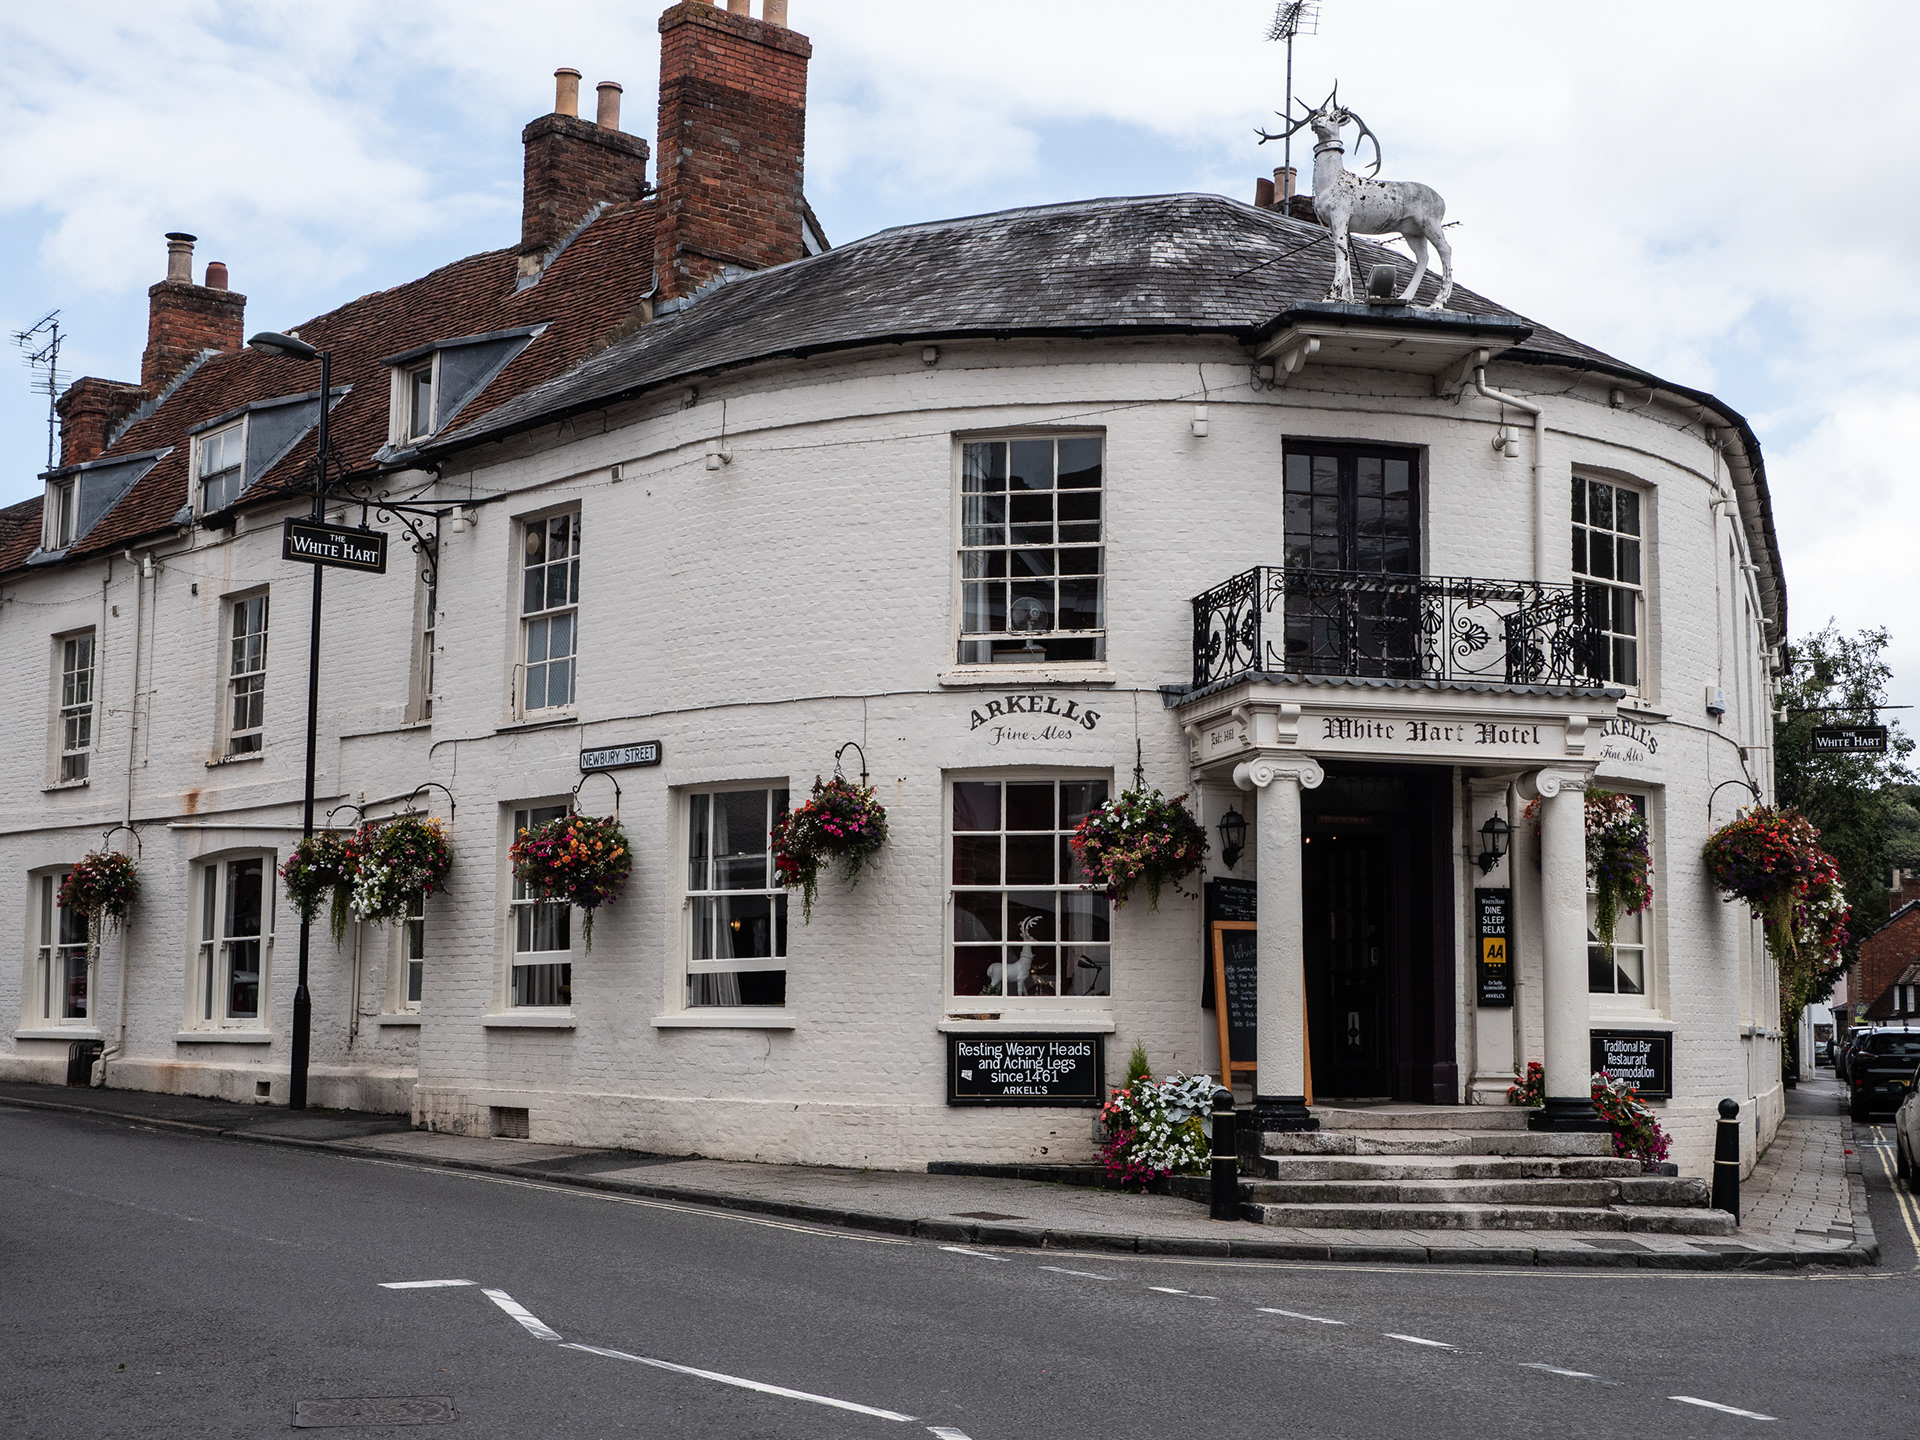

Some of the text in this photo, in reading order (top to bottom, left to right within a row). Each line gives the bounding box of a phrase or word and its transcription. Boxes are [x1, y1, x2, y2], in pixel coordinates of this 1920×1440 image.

[330, 534, 346, 543] THE
[293, 535, 378, 563] WHITE HART
[970, 695, 1101, 731] ARKELLS
[988, 725, 1073, 746] Fine Ales
[1322, 717, 1541, 745] White Hart Hotel
[1816, 736, 1880, 747] WHITE HART
[582, 746, 654, 767] NEWBURY STREET
[1485, 906, 1501, 914] DINE
[1482, 916, 1505, 924] SLEEP
[1482, 925, 1505, 934] RELAX
[1487, 945, 1503, 958] AA
[958, 1042, 1091, 1058] Resting Weary Heads
[1603, 1039, 1652, 1053] Traditional Bar
[978, 1056, 1076, 1073] and Aching Legs
[1607, 1053, 1647, 1065] Restaurant
[1002, 1085, 1048, 1095] ARKELL'S
